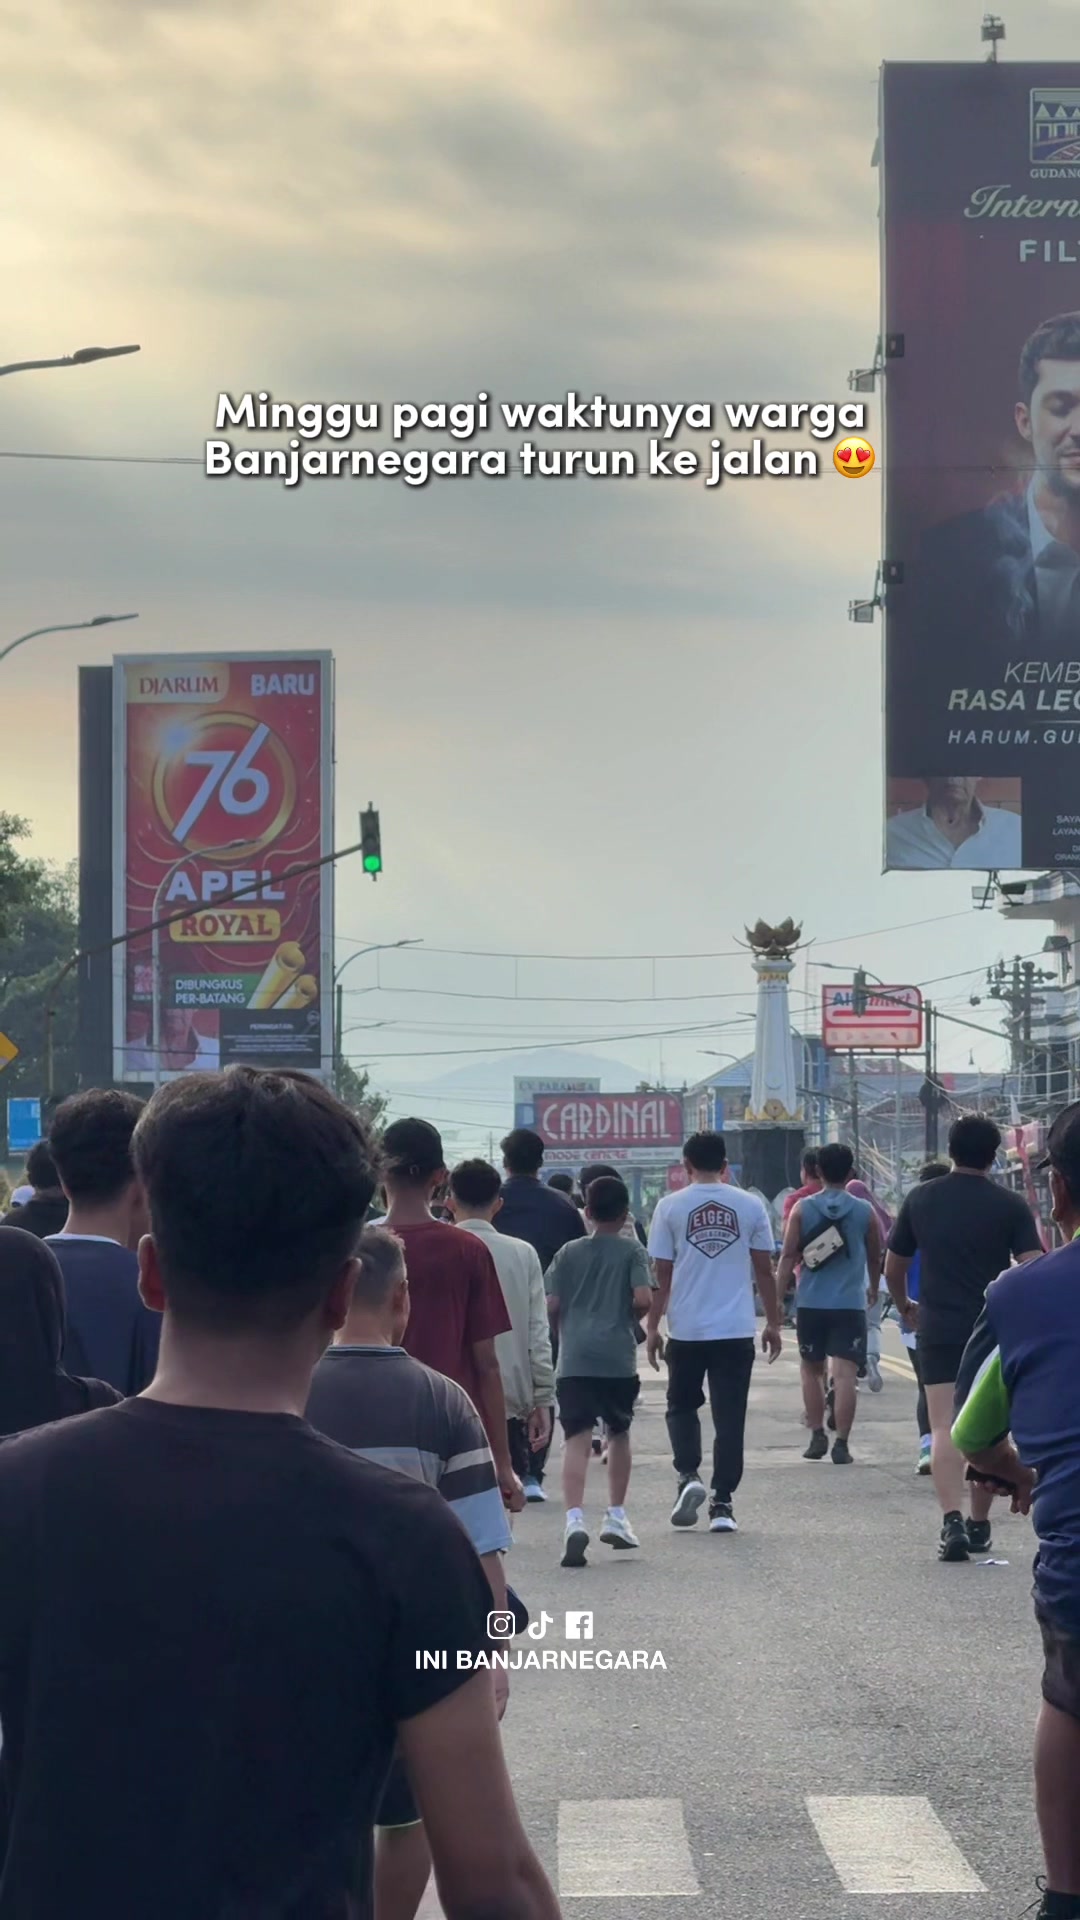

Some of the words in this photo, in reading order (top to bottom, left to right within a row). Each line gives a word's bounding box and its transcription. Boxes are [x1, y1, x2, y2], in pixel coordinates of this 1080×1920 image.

[963, 183, 1080, 219] Intern
[1019, 239, 1080, 263] FIL
[139, 676, 218, 695] DJARUM
[250, 673, 315, 697] BARU
[947, 688, 1026, 711] RASA
[947, 729, 1080, 745] HARUM.GU
[172, 722, 271, 843] 76
[1054, 853, 1080, 861] ORAN
[165, 870, 285, 901] APEL
[180, 914, 272, 937] ROYAL
[175, 978, 243, 990] DIBUNGKUS
[175, 992, 246, 1005] PER-BATANG
[543, 1101, 672, 1140] CARDINAL
[693, 1210, 732, 1227] EIGER
